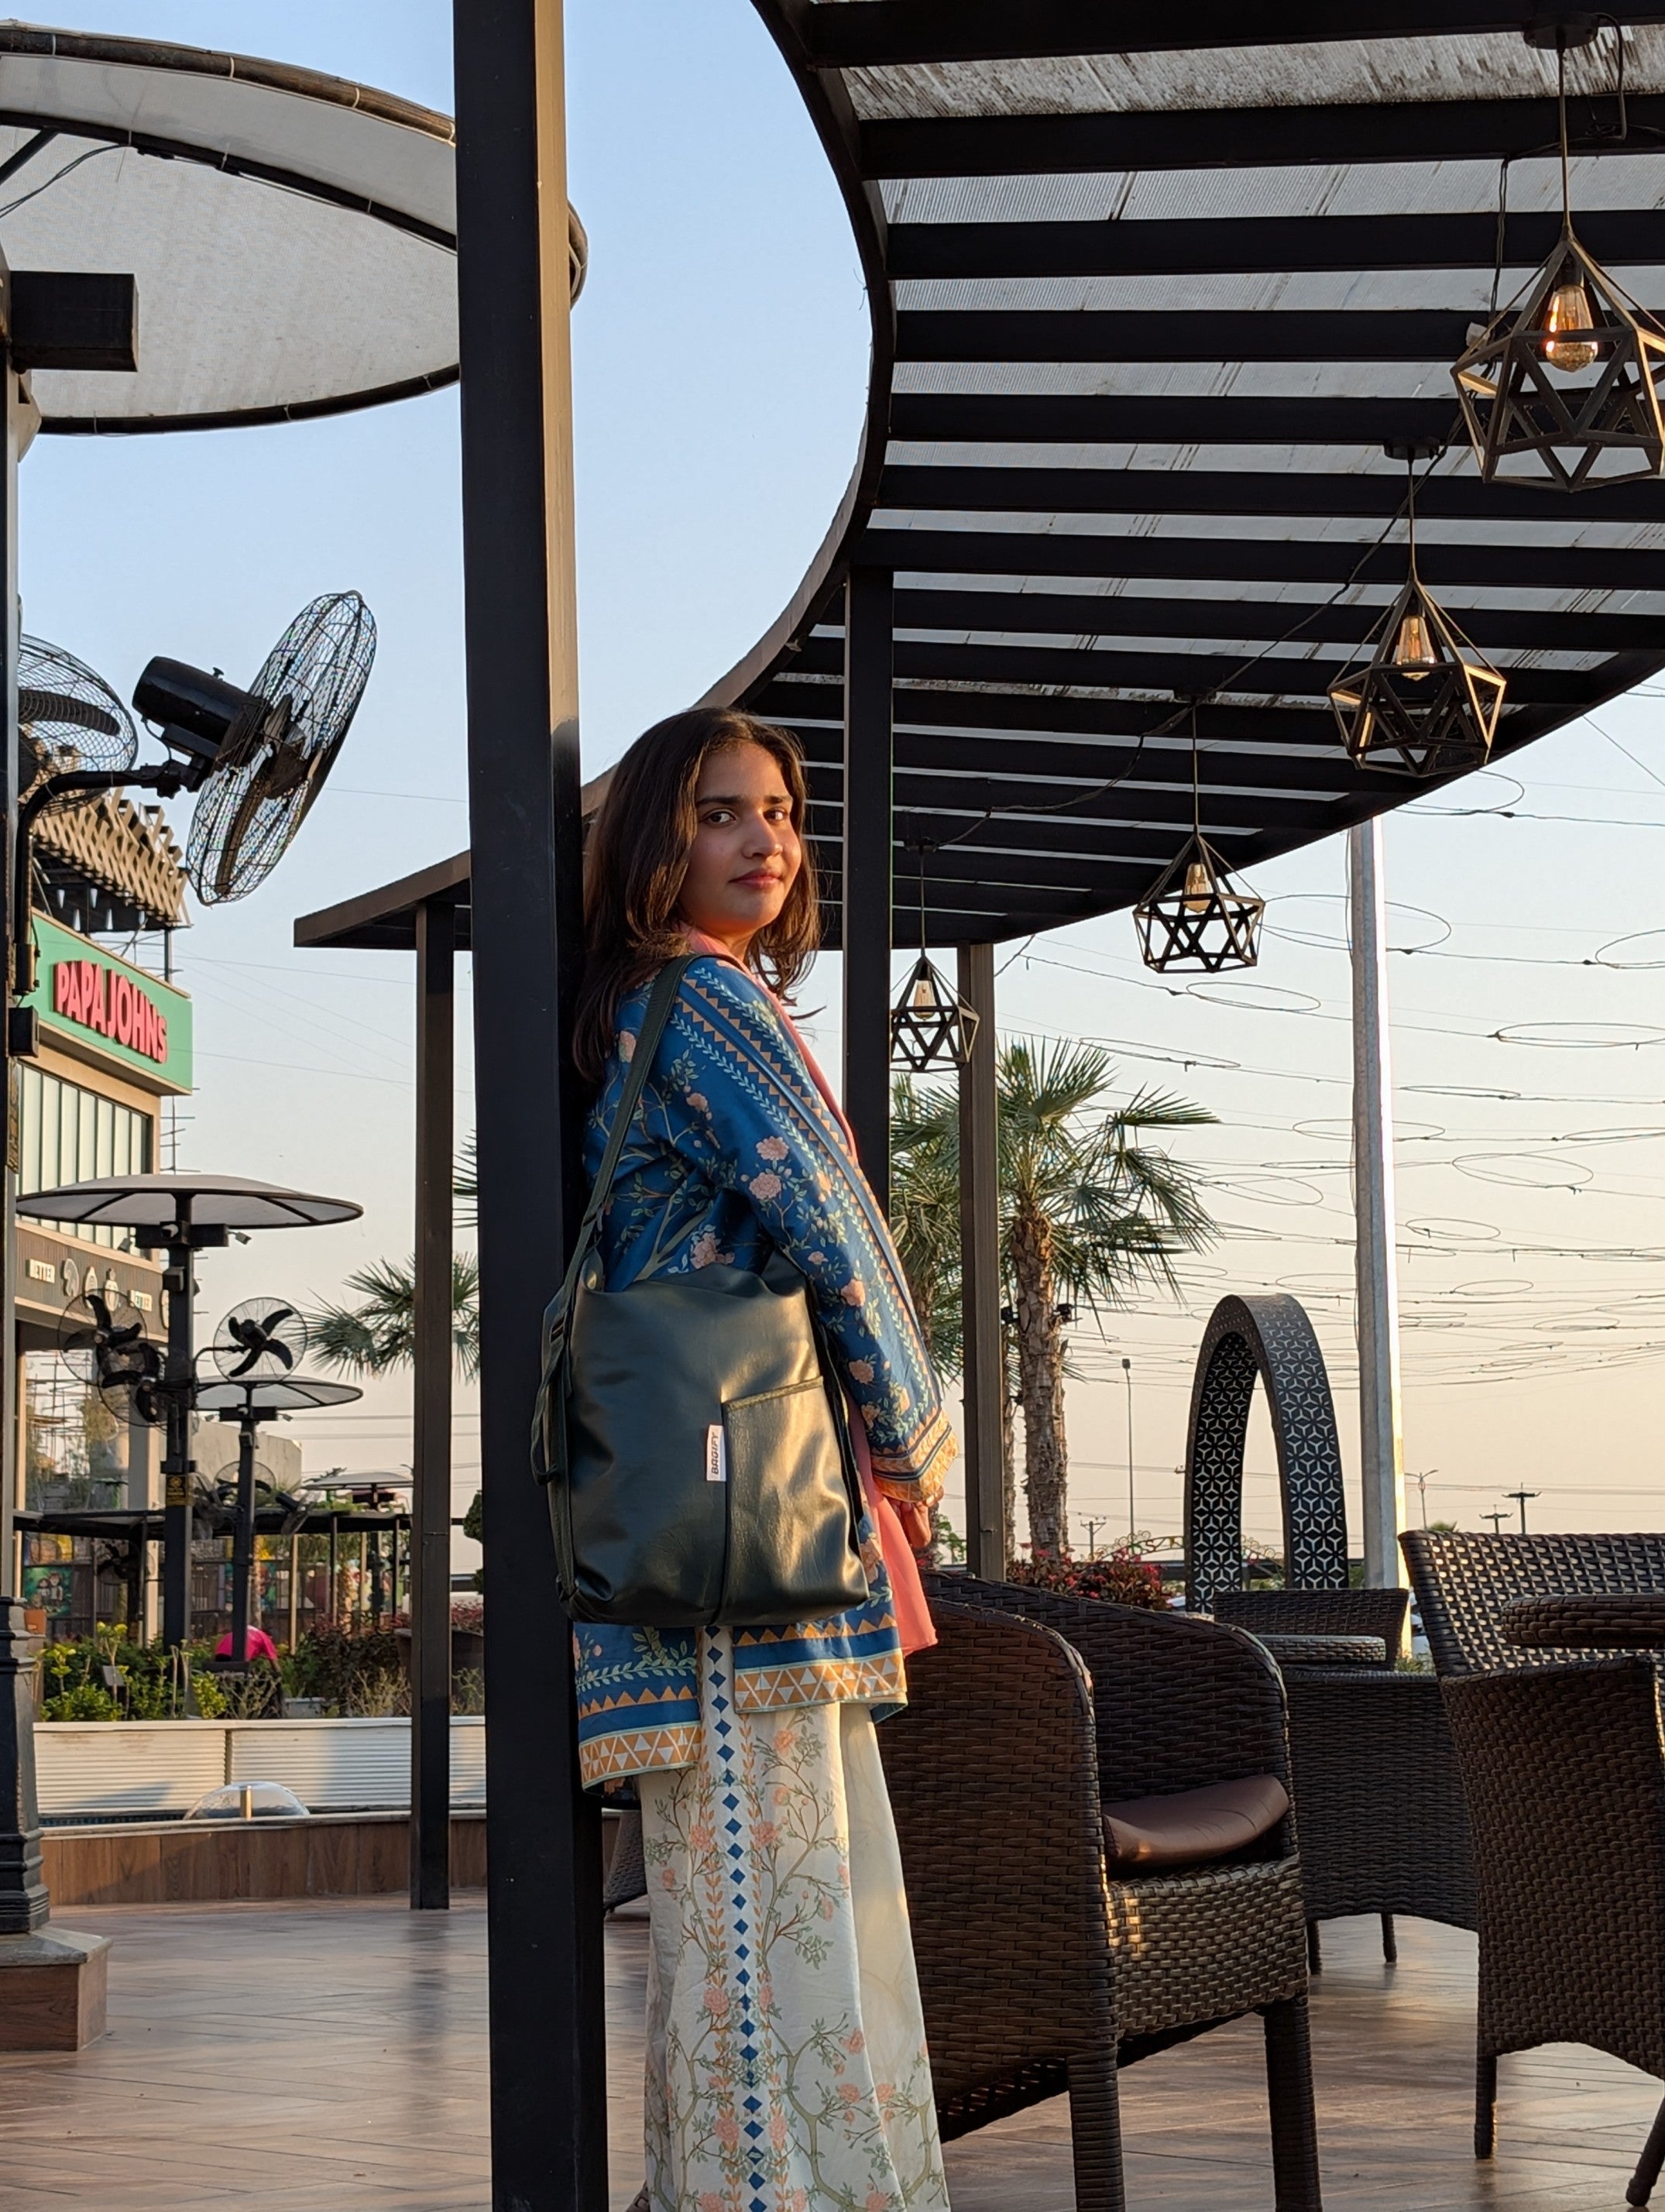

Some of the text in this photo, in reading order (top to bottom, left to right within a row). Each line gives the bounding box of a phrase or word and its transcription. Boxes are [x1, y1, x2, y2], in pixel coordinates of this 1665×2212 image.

[54, 960, 167, 1064] PAPA JOHNS
[711, 1431, 719, 1475] BAGIFY
